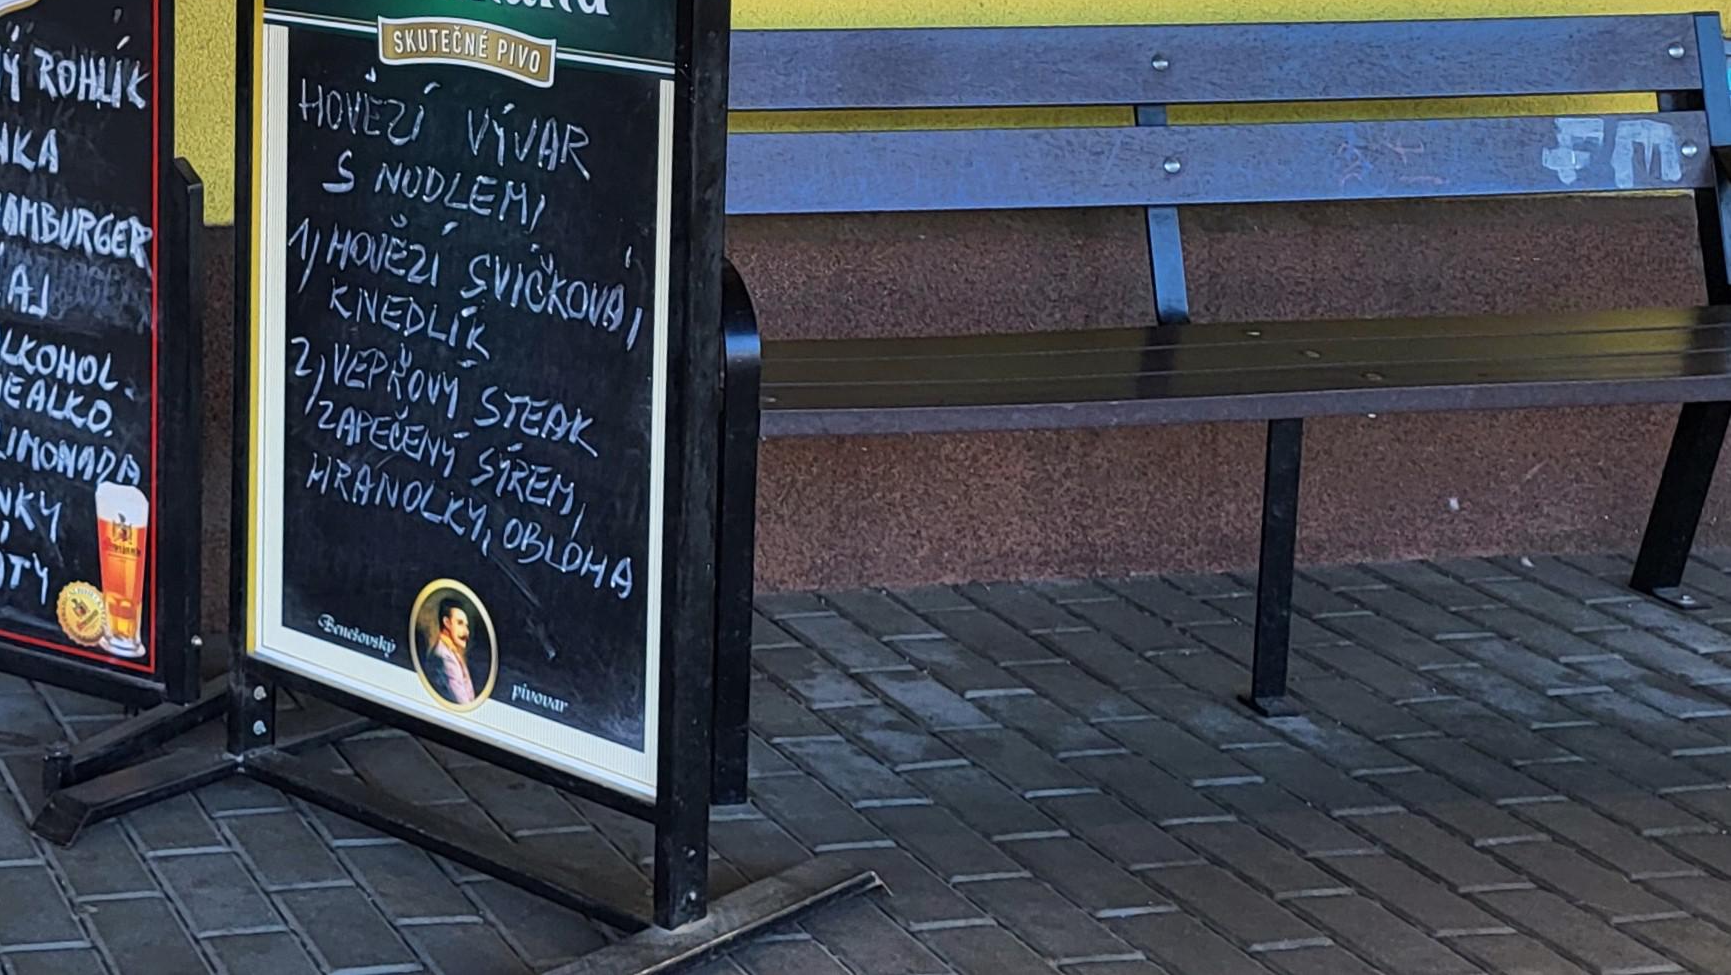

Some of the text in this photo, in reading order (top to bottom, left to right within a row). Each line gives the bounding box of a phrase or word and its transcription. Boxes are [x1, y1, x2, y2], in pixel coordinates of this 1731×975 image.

[34, 36, 149, 109] ROHLÍK
[392, 25, 541, 74] SKUTEČNÉ PIVO
[298, 67, 590, 180] HOVĚZÍ VÝVAR
[322, 150, 355, 193] S
[327, 214, 458, 287] HOVĚZÍ
[330, 278, 490, 361] KNEDLÍK
[318, 400, 470, 477] ZAPEČENÝ
[473, 386, 599, 458] STEAK
[317, 613, 397, 658] Benešovský
[511, 682, 569, 714] pivovar
